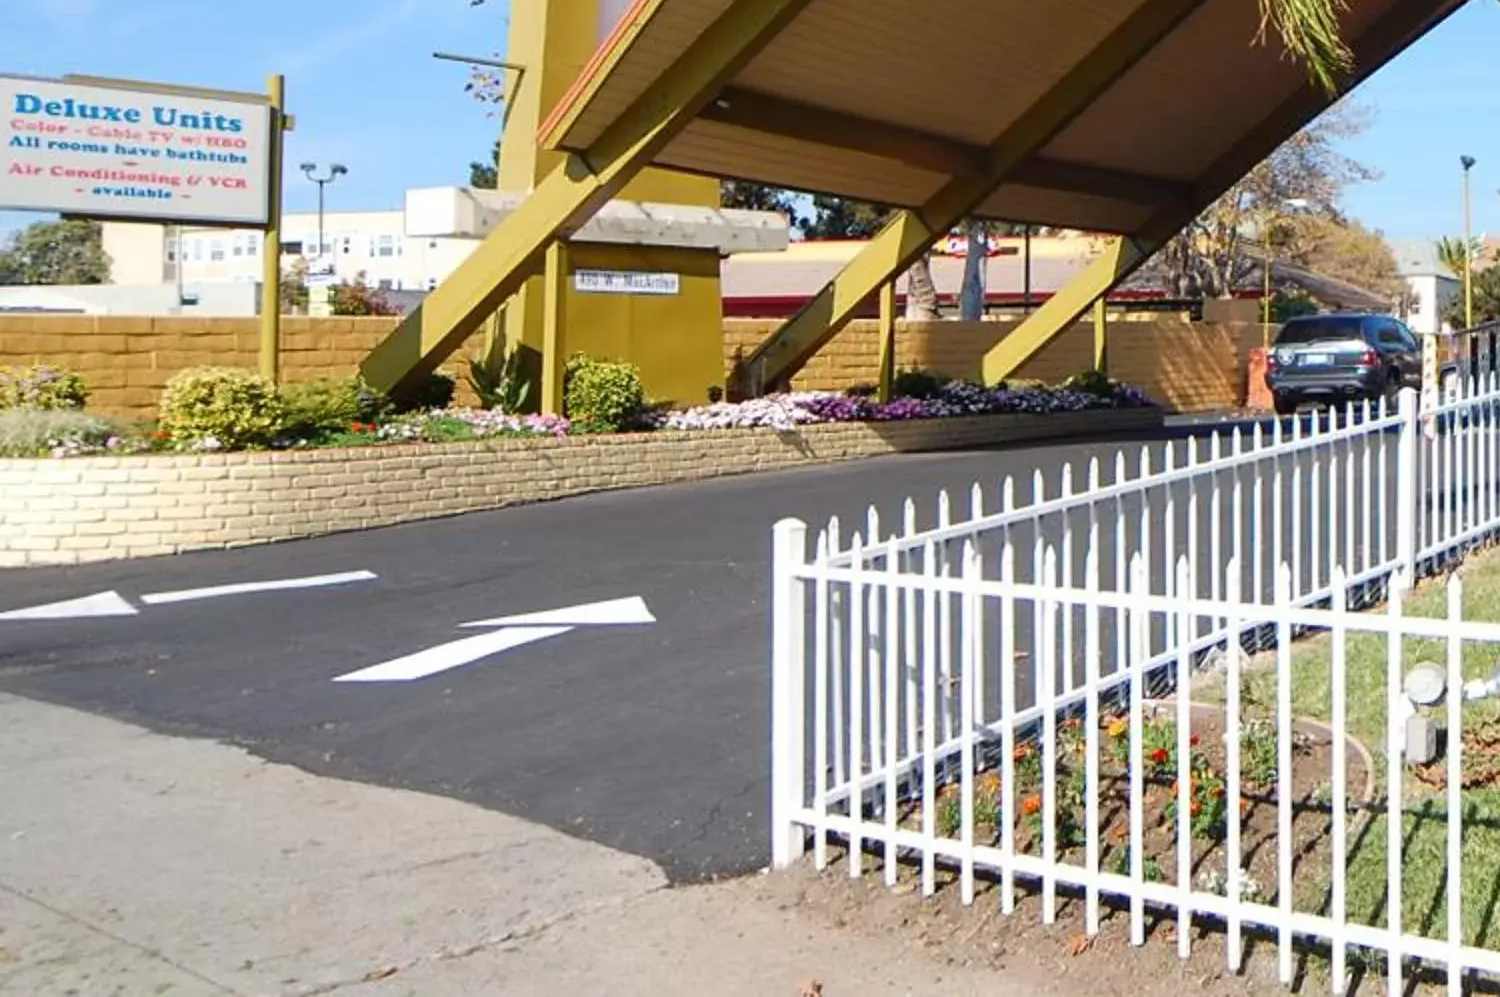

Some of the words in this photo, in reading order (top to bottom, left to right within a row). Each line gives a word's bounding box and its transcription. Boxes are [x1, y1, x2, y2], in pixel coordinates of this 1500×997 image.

[15, 94, 142, 124] Deluxe
[152, 107, 243, 133] Units
[10, 118, 69, 135] Color
[86, 124, 143, 142] Cable
[147, 129, 175, 144] TV
[205, 136, 248, 149] HBO
[9, 135, 40, 149] All
[47, 140, 109, 155] rooms
[113, 142, 160, 158] have
[165, 148, 249, 164] bathtubs
[8, 162, 44, 176] Air
[50, 164, 182, 187] Conditioning
[208, 176, 249, 189] VCR
[92, 186, 174, 199] available
